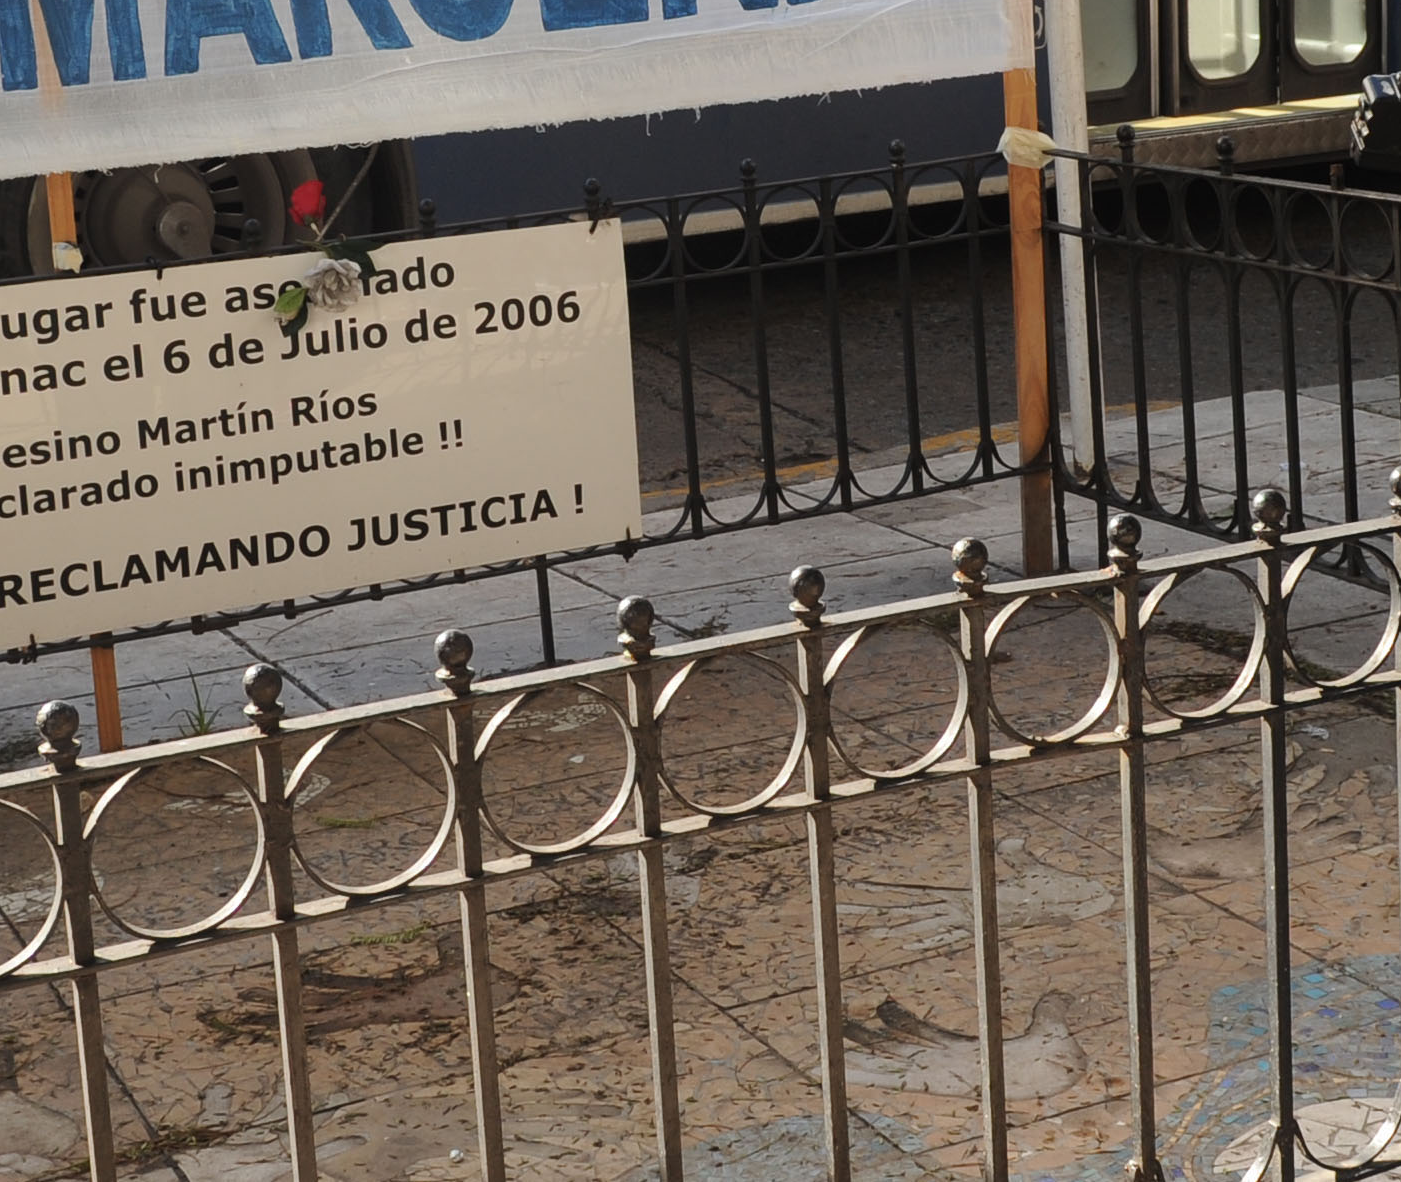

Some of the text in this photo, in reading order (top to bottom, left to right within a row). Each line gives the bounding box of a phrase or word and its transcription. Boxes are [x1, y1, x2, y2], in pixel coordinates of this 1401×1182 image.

[129, 288, 207, 324] fue
[225, 257, 455, 313] aseado
[103, 345, 144, 382] el
[163, 339, 190, 374] 6
[208, 333, 264, 370] de
[280, 318, 388, 361] Julio
[404, 309, 457, 344] de
[474, 290, 581, 335] 2006
[138, 397, 275, 450] Martín
[290, 389, 378, 428] Ríos
[175, 427, 425, 493] inimputable
[438, 419, 465, 451] !!
[347, 488, 559, 552] JUSTICIA
[573, 483, 585, 514] !
